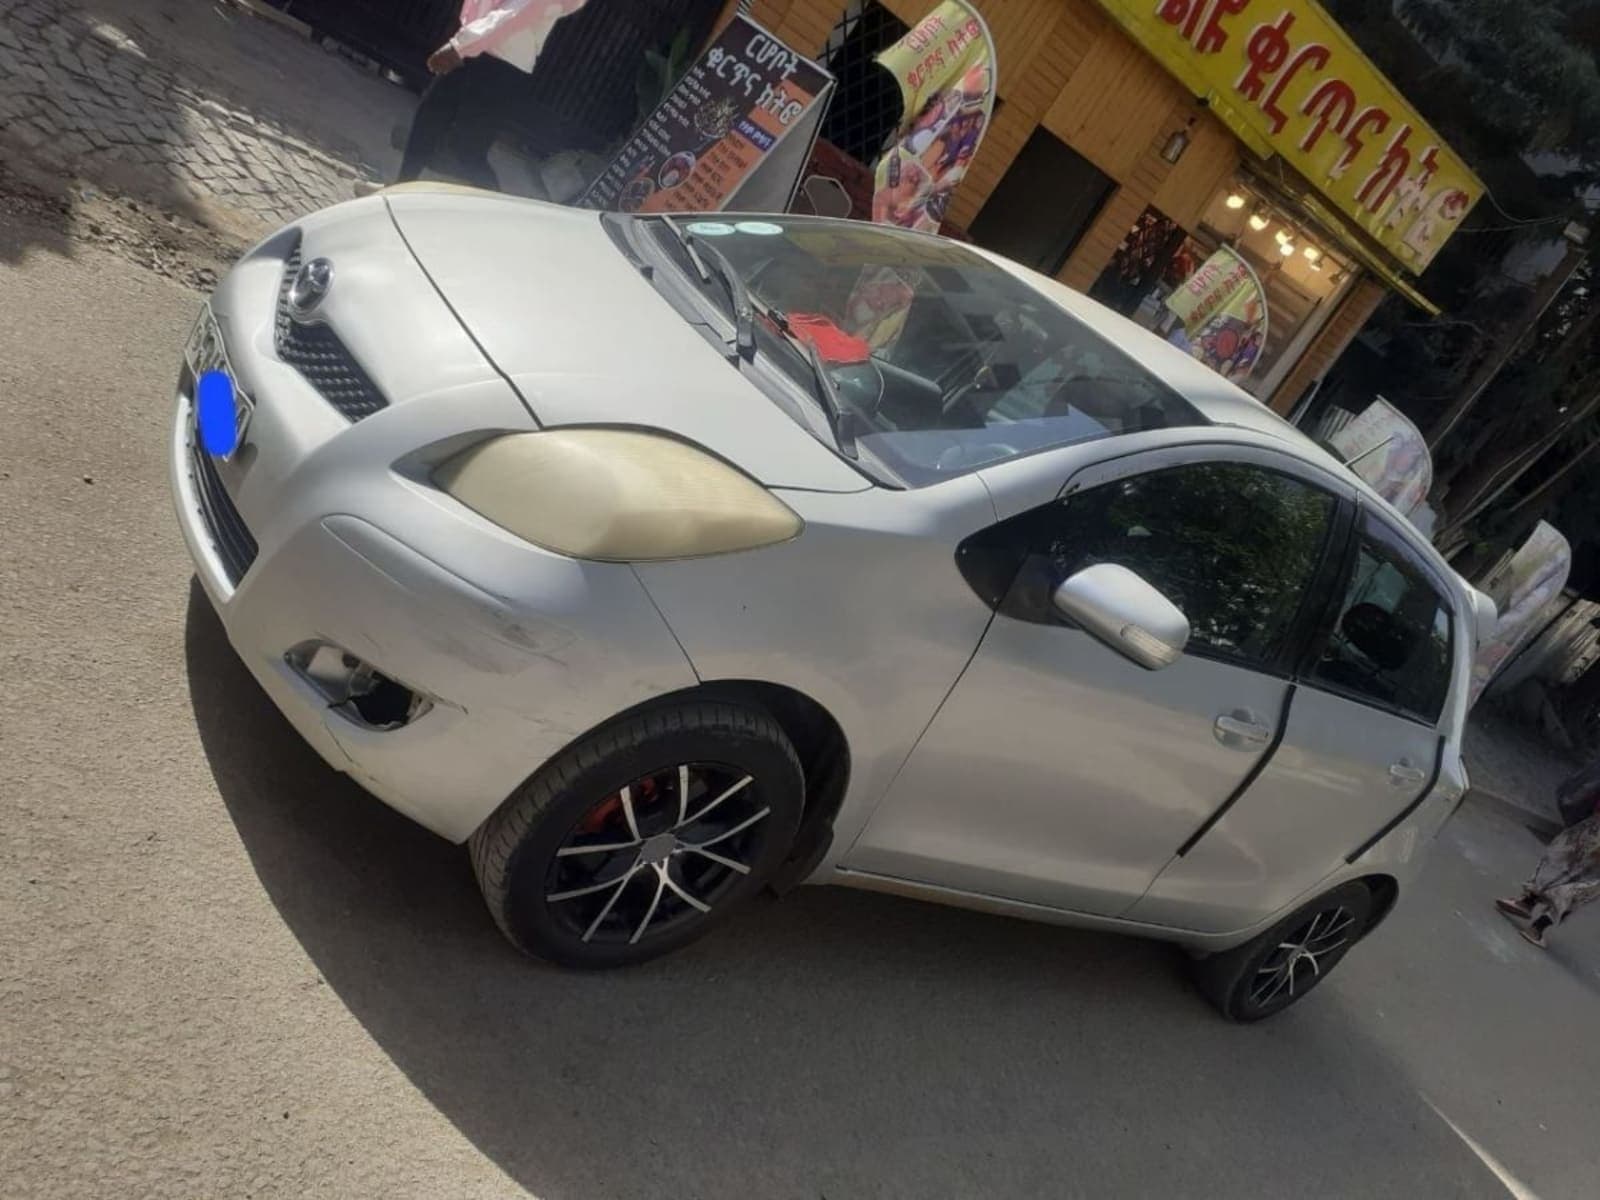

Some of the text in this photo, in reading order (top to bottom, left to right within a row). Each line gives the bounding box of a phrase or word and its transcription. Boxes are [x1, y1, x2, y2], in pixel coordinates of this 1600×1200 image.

[706, 47, 802, 124] ቁርጥና ክትፎ
[745, 33, 799, 80] ርሆቦት
[1233, 11, 1391, 181] ቁርጥና
[1354, 124, 1470, 256] ክትፎ
